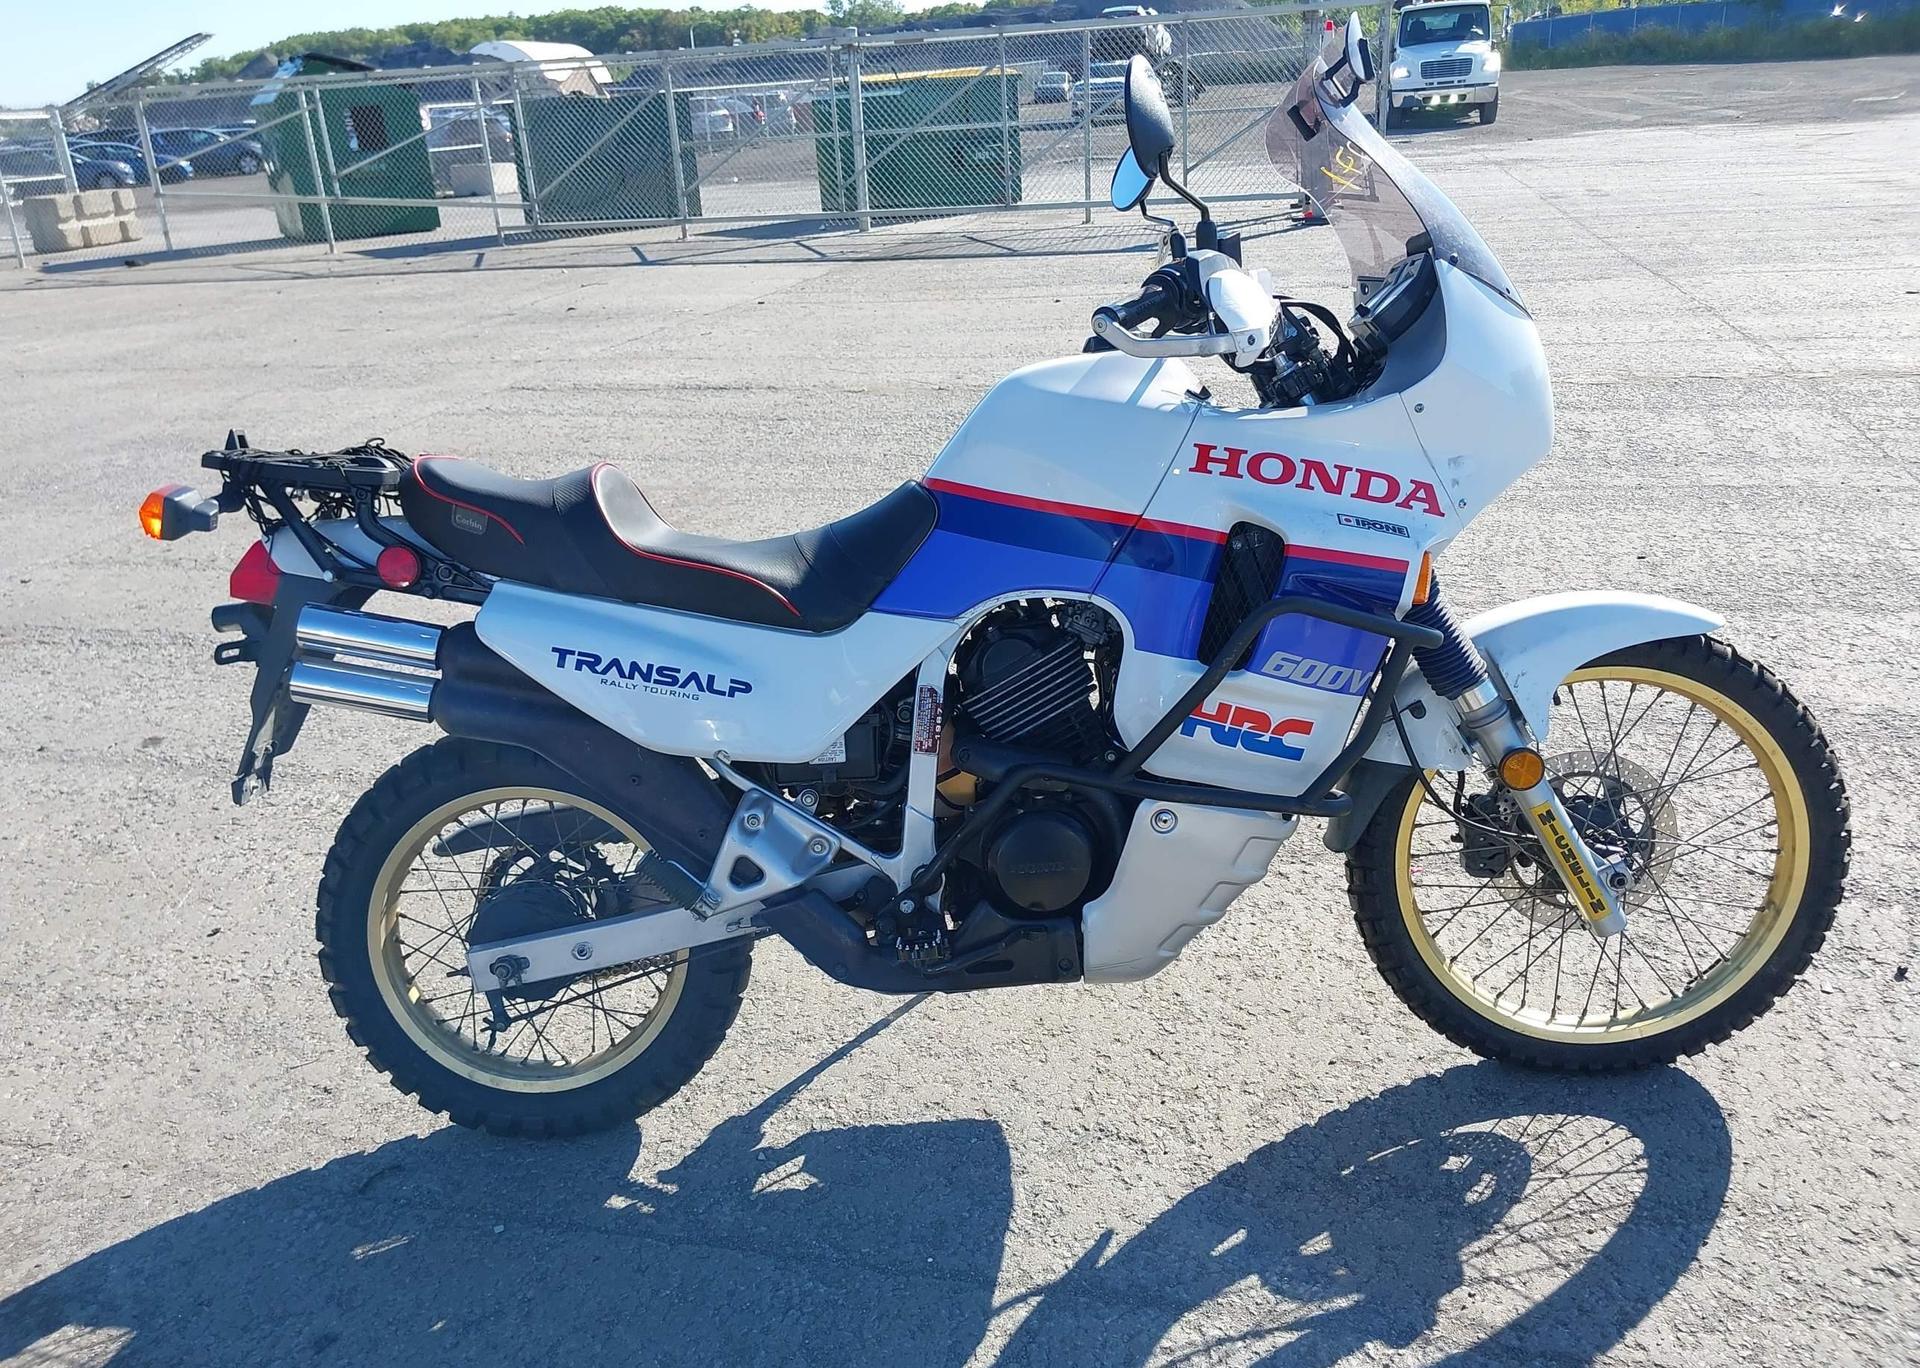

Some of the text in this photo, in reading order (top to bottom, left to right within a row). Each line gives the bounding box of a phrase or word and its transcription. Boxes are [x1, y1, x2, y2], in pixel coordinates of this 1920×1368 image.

[1189, 443, 1446, 517] HONDA
[1354, 518, 1407, 536] IPONE
[551, 647, 752, 699] TRANSALP
[600, 677, 701, 701] RALLY TOURING
[1261, 651, 1374, 693] 600V
[1180, 701, 1315, 761] HRC
[1538, 808, 1606, 914] MICHELIN
